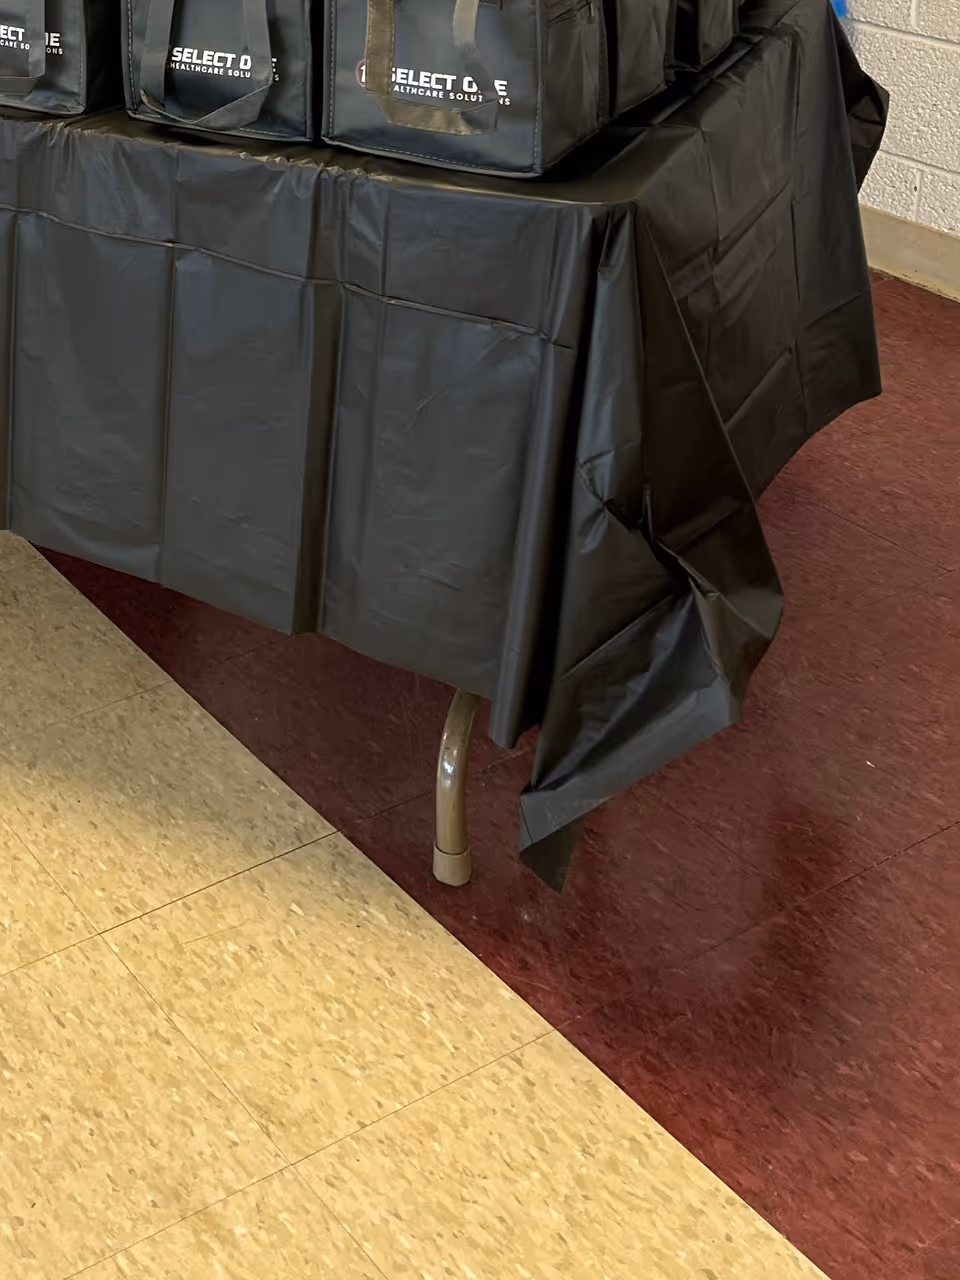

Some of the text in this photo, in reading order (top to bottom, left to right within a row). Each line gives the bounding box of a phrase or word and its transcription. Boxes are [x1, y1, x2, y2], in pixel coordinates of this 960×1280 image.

[20, 43, 63, 55] SOONS
[171, 46, 236, 68] SELECT
[170, 62, 224, 76] HEALTHCARE
[393, 84, 444, 99] ALTHCARE
[462, 76, 508, 96] OE
